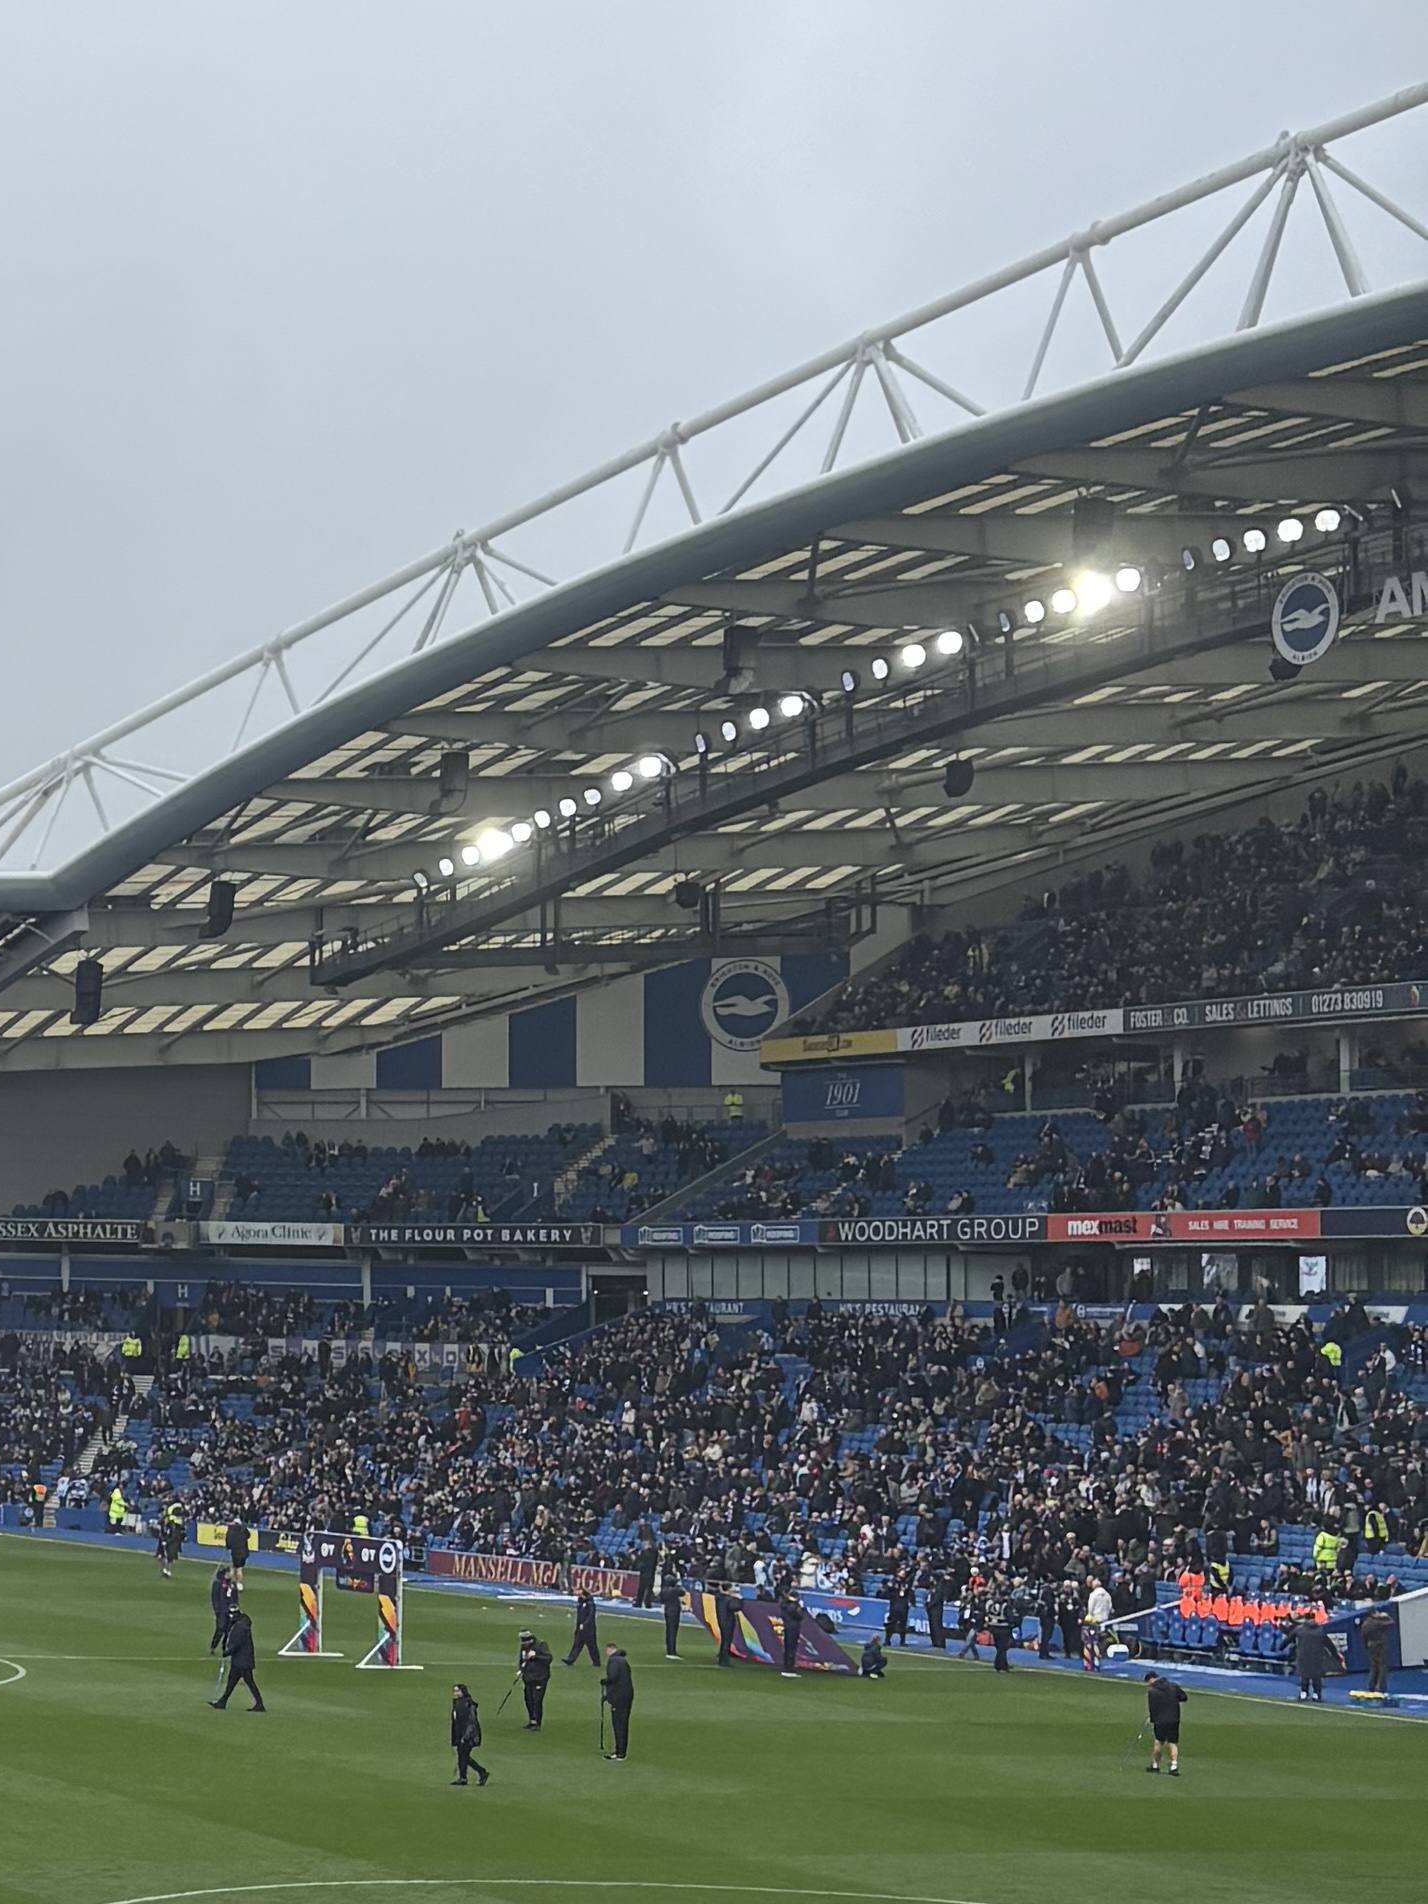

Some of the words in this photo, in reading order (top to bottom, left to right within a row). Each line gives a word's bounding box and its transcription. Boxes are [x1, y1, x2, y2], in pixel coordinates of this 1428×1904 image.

[1129, 1010, 1163, 1029] FOSTER
[1173, 1007, 1189, 1025] CO.
[1205, 1004, 1235, 1022] SALES
[1247, 998, 1293, 1019] LETTINGS
[1311, 993, 1343, 1013] 01273
[1343, 990, 1384, 1011] 830919
[995, 1019, 1033, 1037] fileder
[1067, 1013, 1107, 1031] fileder
[925, 1026, 962, 1042] fileder
[826, 1082, 860, 1106] 1901
[189, 1182, 201, 1196] H
[44, 1222, 138, 1240] ASPHALTE
[231, 1225, 269, 1240] Agora
[271, 1225, 312, 1239] Clinic
[838, 1218, 952, 1241] WOODHART
[957, 1216, 1040, 1240] GROUP
[1067, 1216, 1138, 1236] mexmast
[1188, 1220, 1210, 1230] SALES
[369, 1229, 398, 1241] THE
[405, 1229, 455, 1241] FLOUR
[463, 1229, 493, 1241] POT
[501, 1229, 572, 1242] BAKERY
[178, 1284, 188, 1298] H
[452, 1554, 527, 1585] MANSELL
